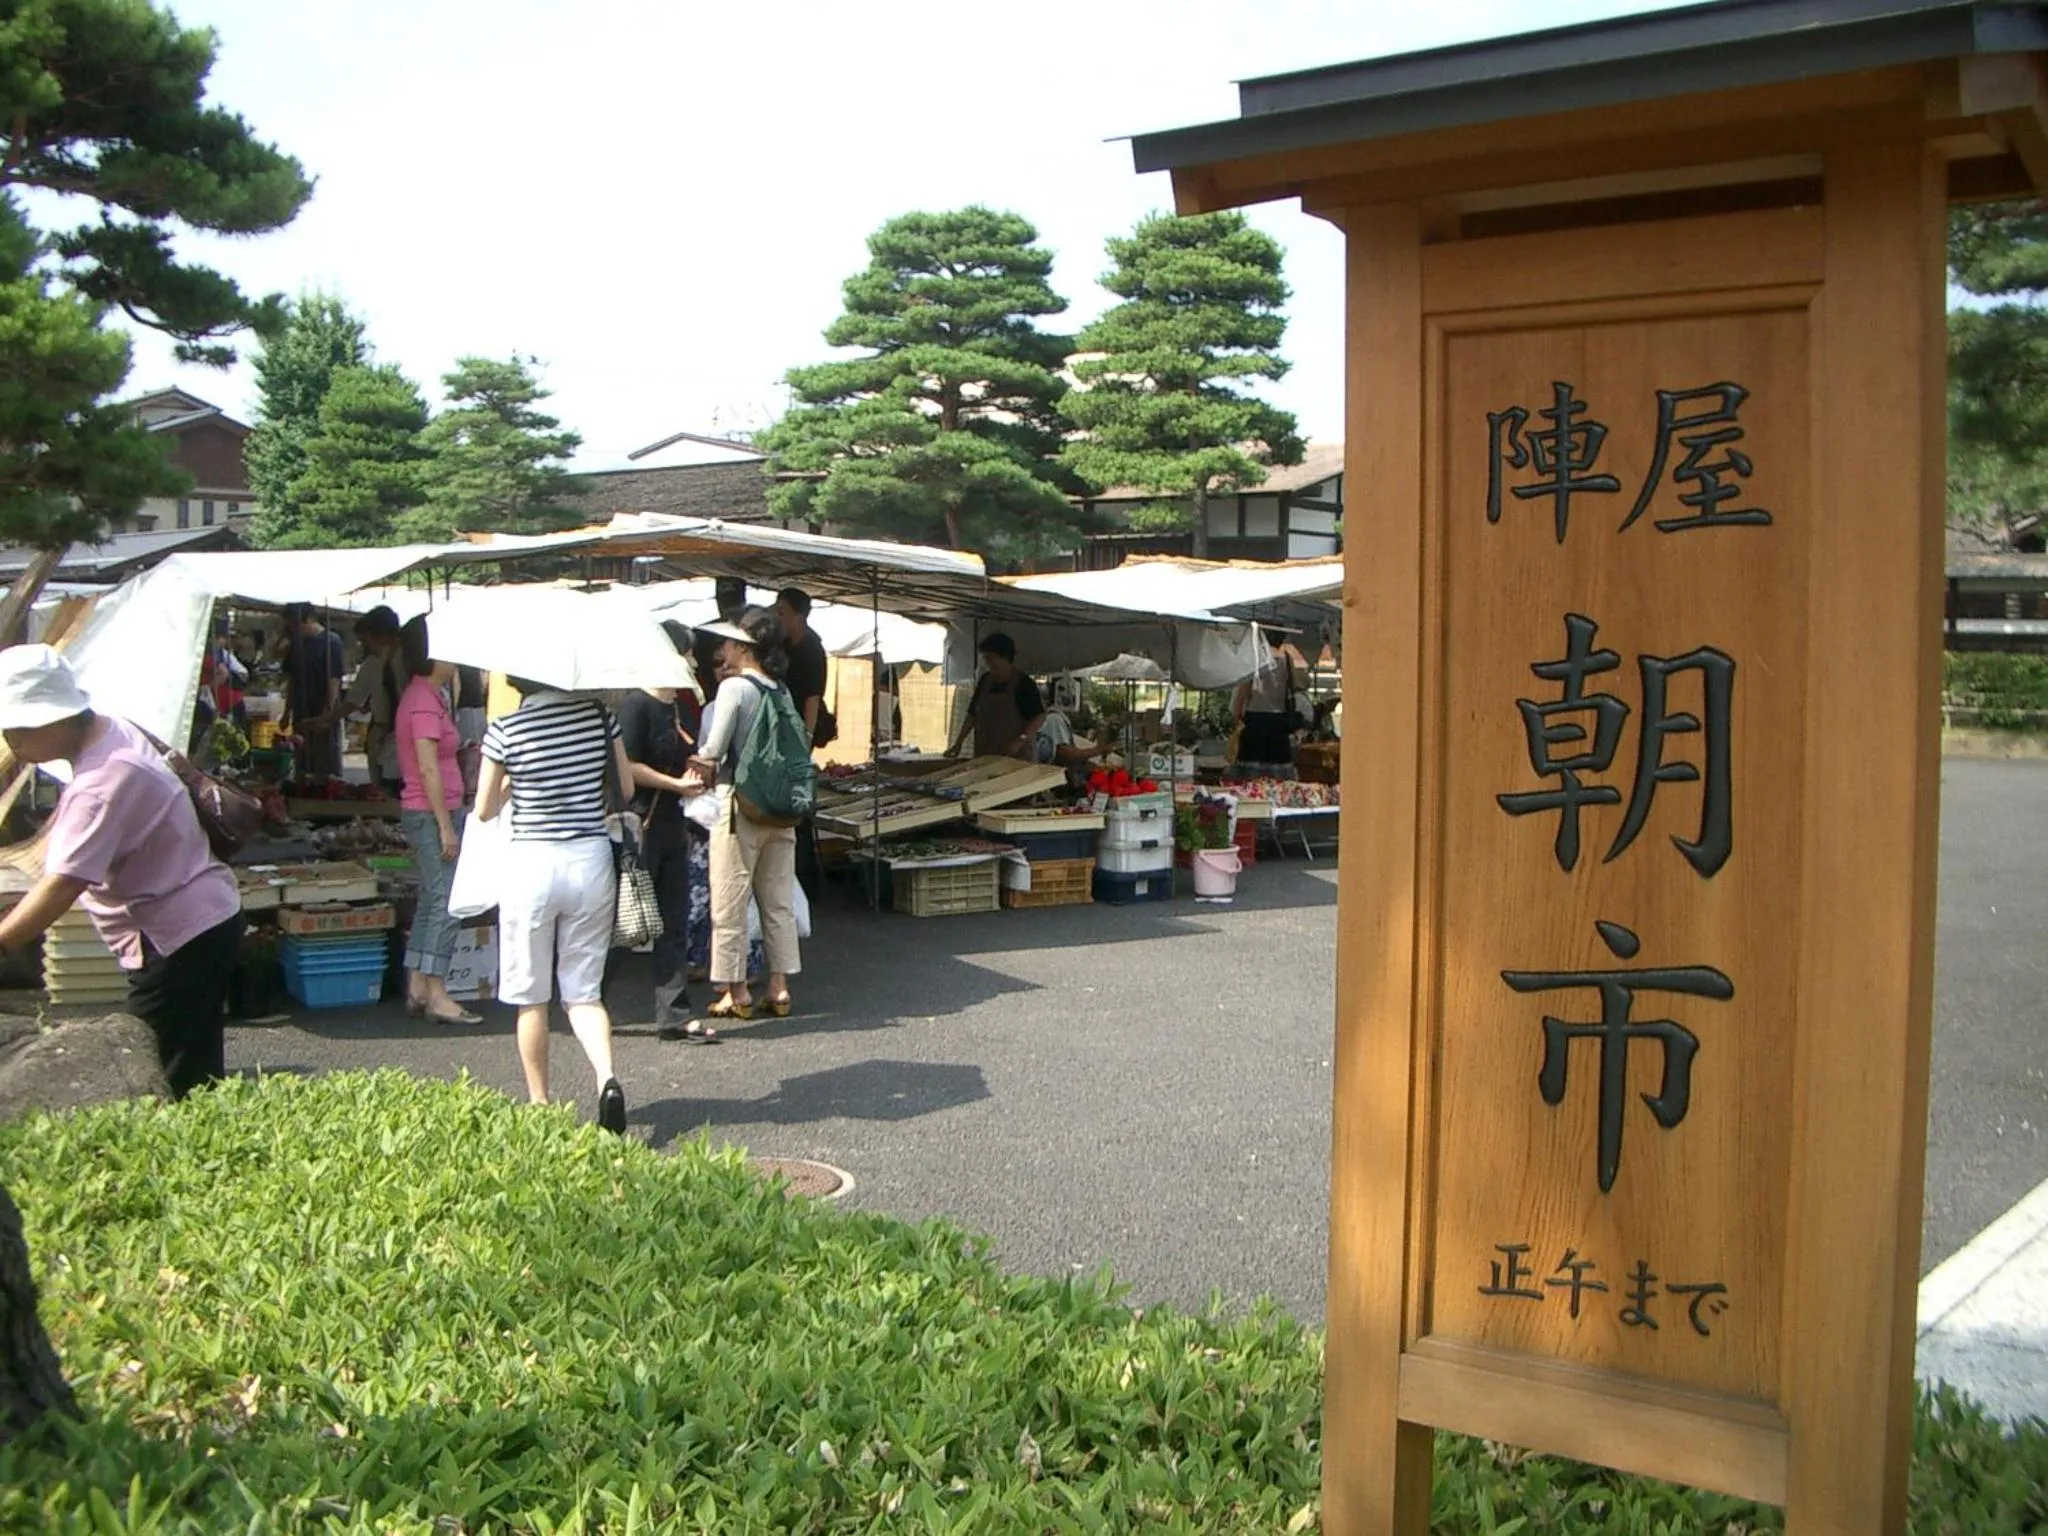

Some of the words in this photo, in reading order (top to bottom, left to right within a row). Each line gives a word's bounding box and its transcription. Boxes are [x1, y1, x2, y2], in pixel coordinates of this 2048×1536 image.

[1486, 380, 1773, 544] 陣屋
[1496, 612, 1736, 1195] 朝市
[1477, 1243, 1730, 1337] 正午まで
